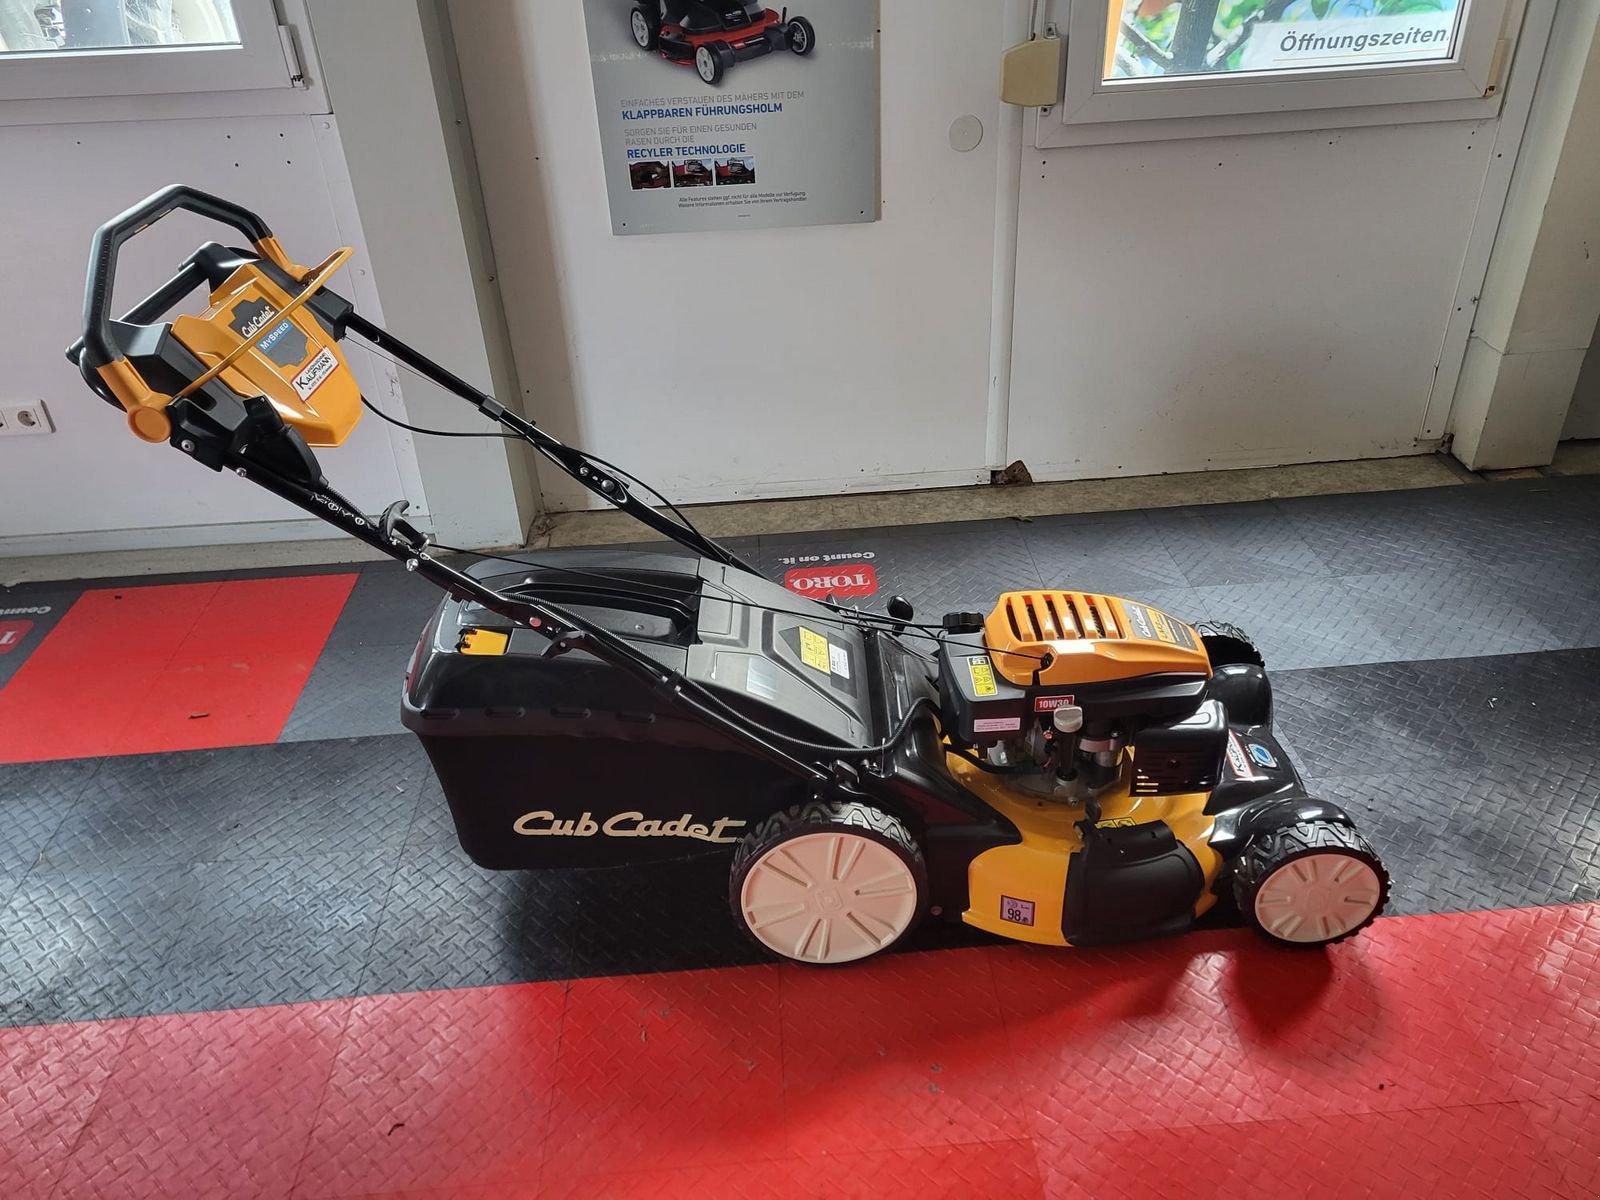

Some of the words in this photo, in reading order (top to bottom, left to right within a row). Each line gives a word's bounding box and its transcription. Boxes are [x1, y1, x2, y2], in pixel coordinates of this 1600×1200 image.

[620, 97, 666, 108] EINFACHES
[666, 94, 714, 105] VERSTAUEN
[717, 94, 732, 104] DES
[771, 91, 785, 100] MIT
[787, 90, 804, 99] DEM
[622, 107, 693, 120] KLAPPBAREN
[694, 102, 782, 117] FÜHRUNGSHOLM
[624, 126, 656, 136] SORGEN
[658, 126, 670, 136] SIE
[672, 124, 688, 134] FÜR
[690, 124, 714, 134] EINEN
[715, 122, 758, 132] GESUNDEN
[626, 136, 652, 146] RASEN
[654, 135, 682, 144] DURCH
[682, 134, 694, 144] DIE
[627, 146, 673, 158] RECYLER
[676, 144, 746, 156] TECHNOLOGIE
[241, 320, 256, 338] Cub
[253, 306, 275, 328] Cadet
[296, 355, 332, 390] KAUFMANN
[823, 552, 875, 562] Count
[792, 574, 870, 590] TORO
[1039, 698, 1069, 709] 10W30
[513, 810, 599, 837] Cub
[602, 811, 748, 844] Cadet
[1007, 908, 1021, 922] 98
